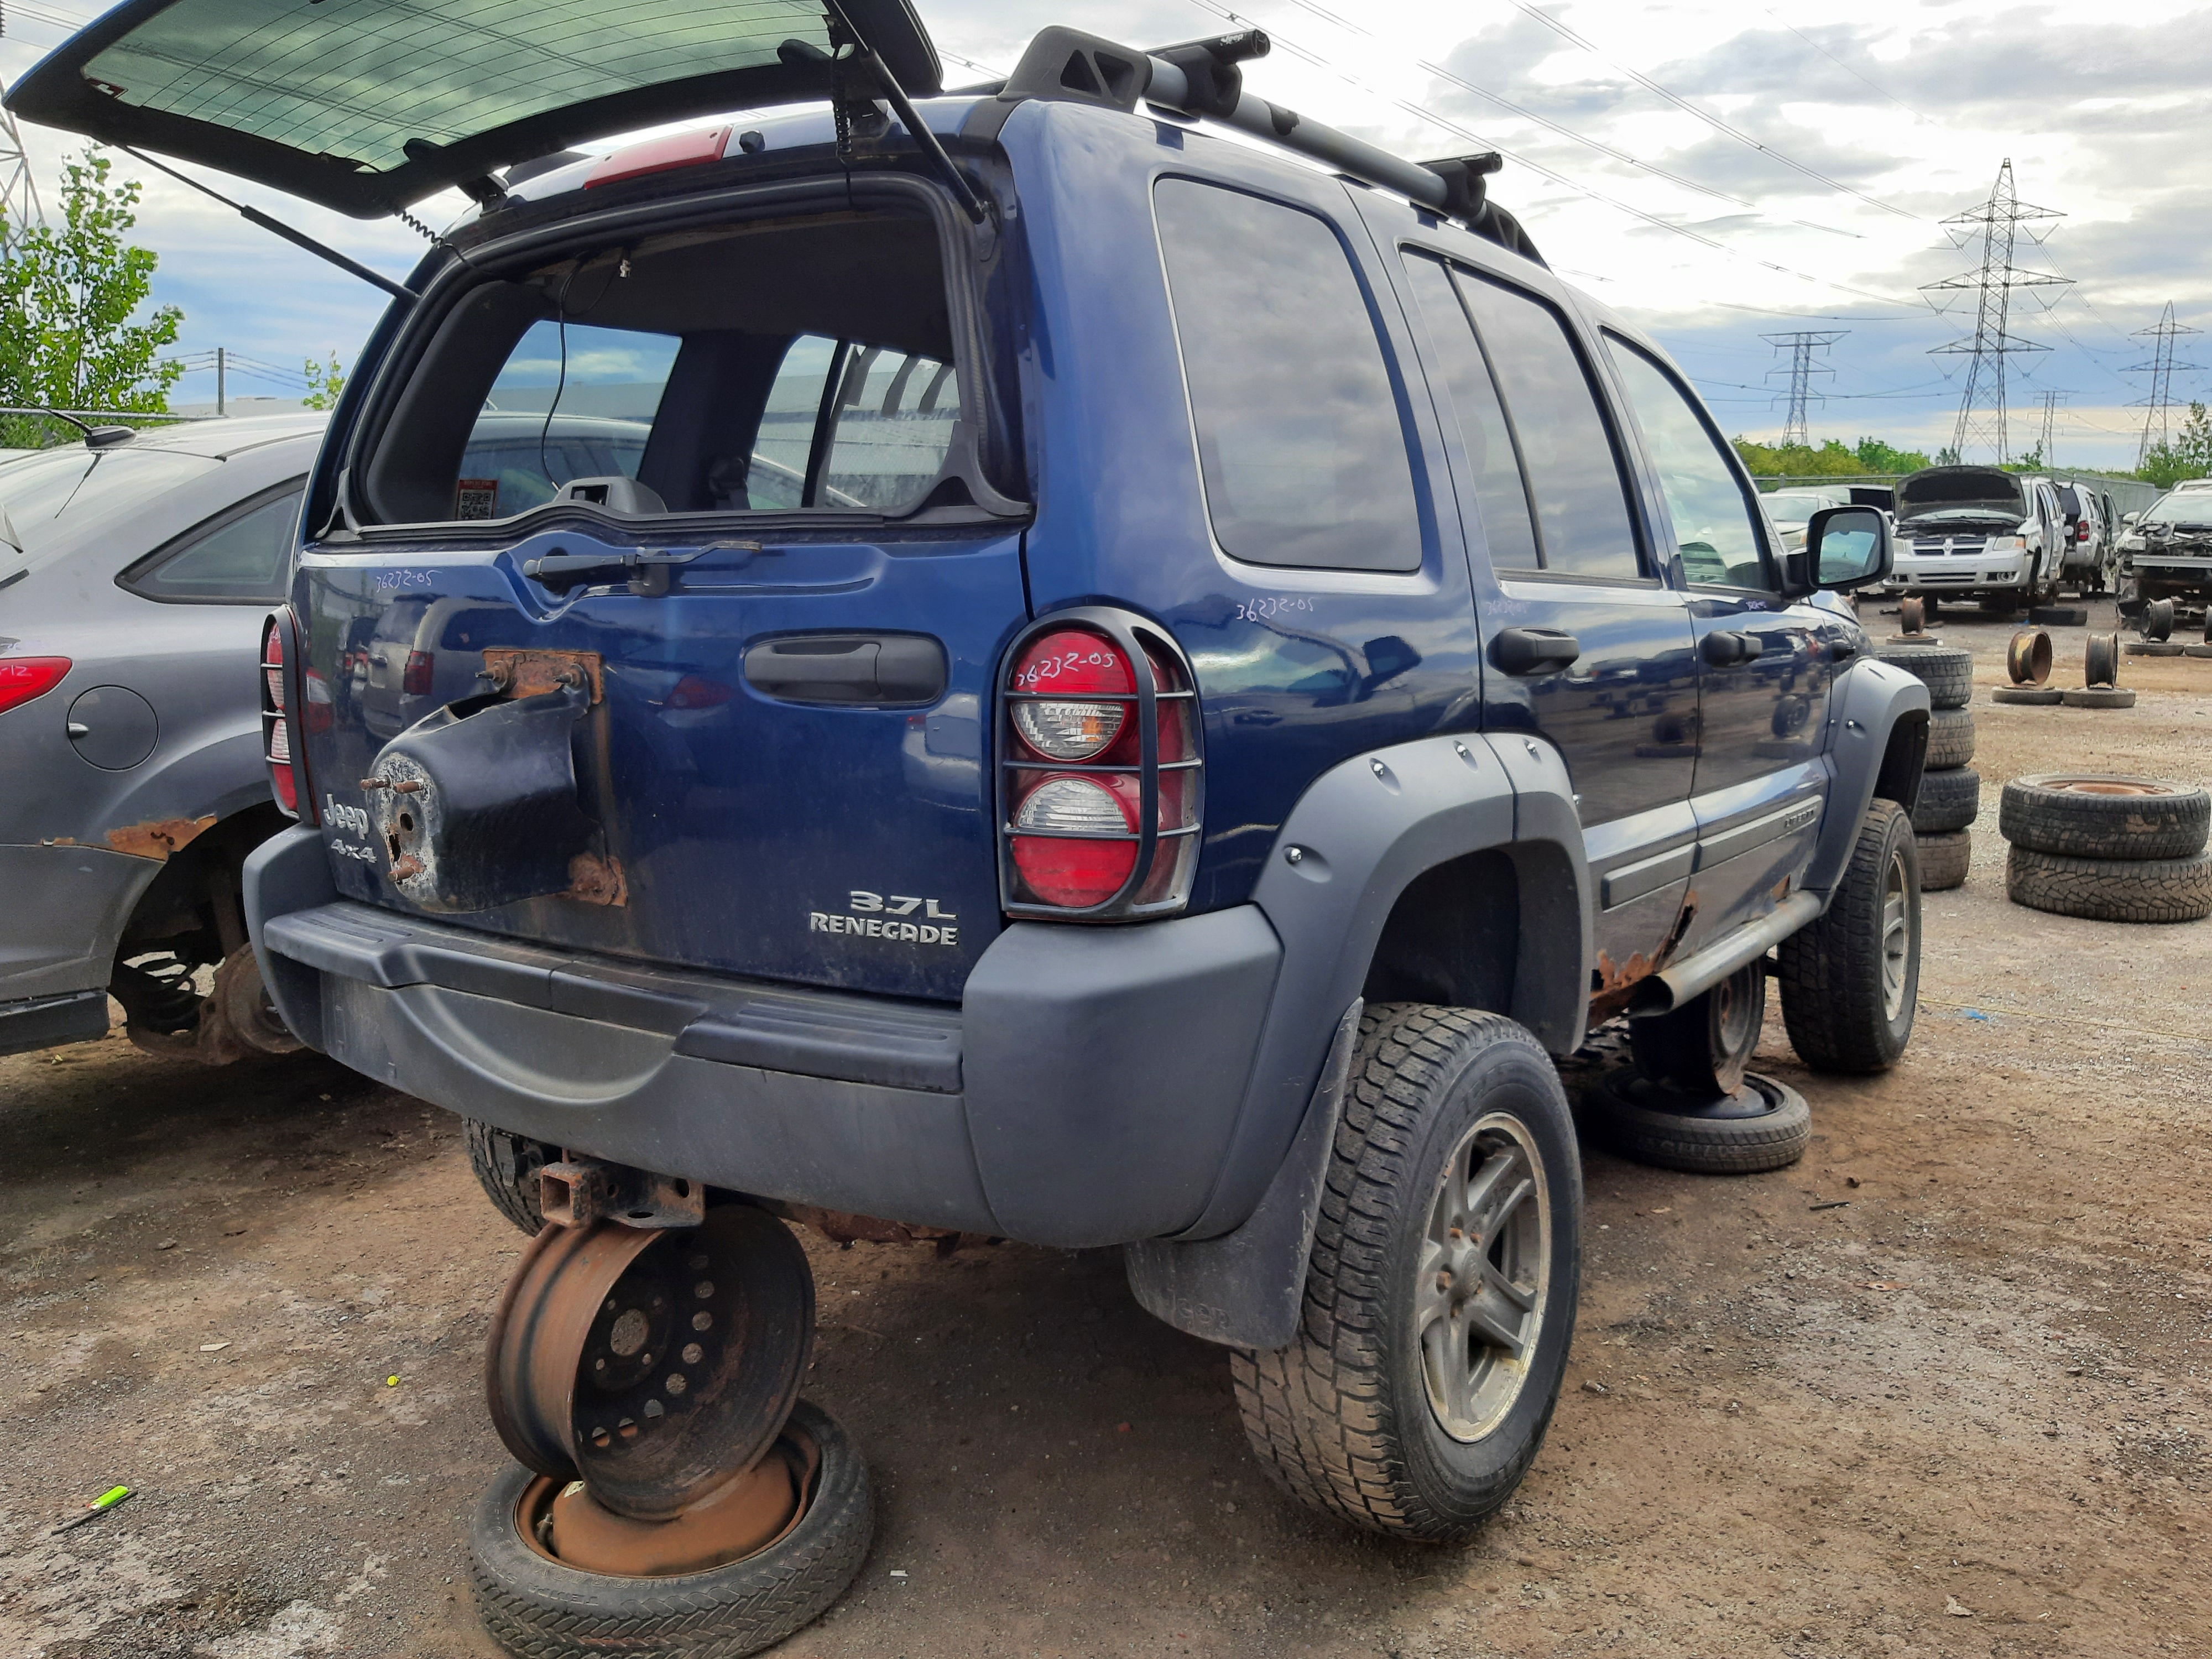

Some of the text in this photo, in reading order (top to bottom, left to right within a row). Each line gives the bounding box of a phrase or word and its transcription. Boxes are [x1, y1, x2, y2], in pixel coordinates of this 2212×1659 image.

[376, 569, 442, 593] 36232-05
[1236, 597, 1322, 622] 36232-05
[323, 793, 369, 840] Jeep
[850, 890, 957, 920] 3.7L
[810, 911, 958, 946] RENEGADE
